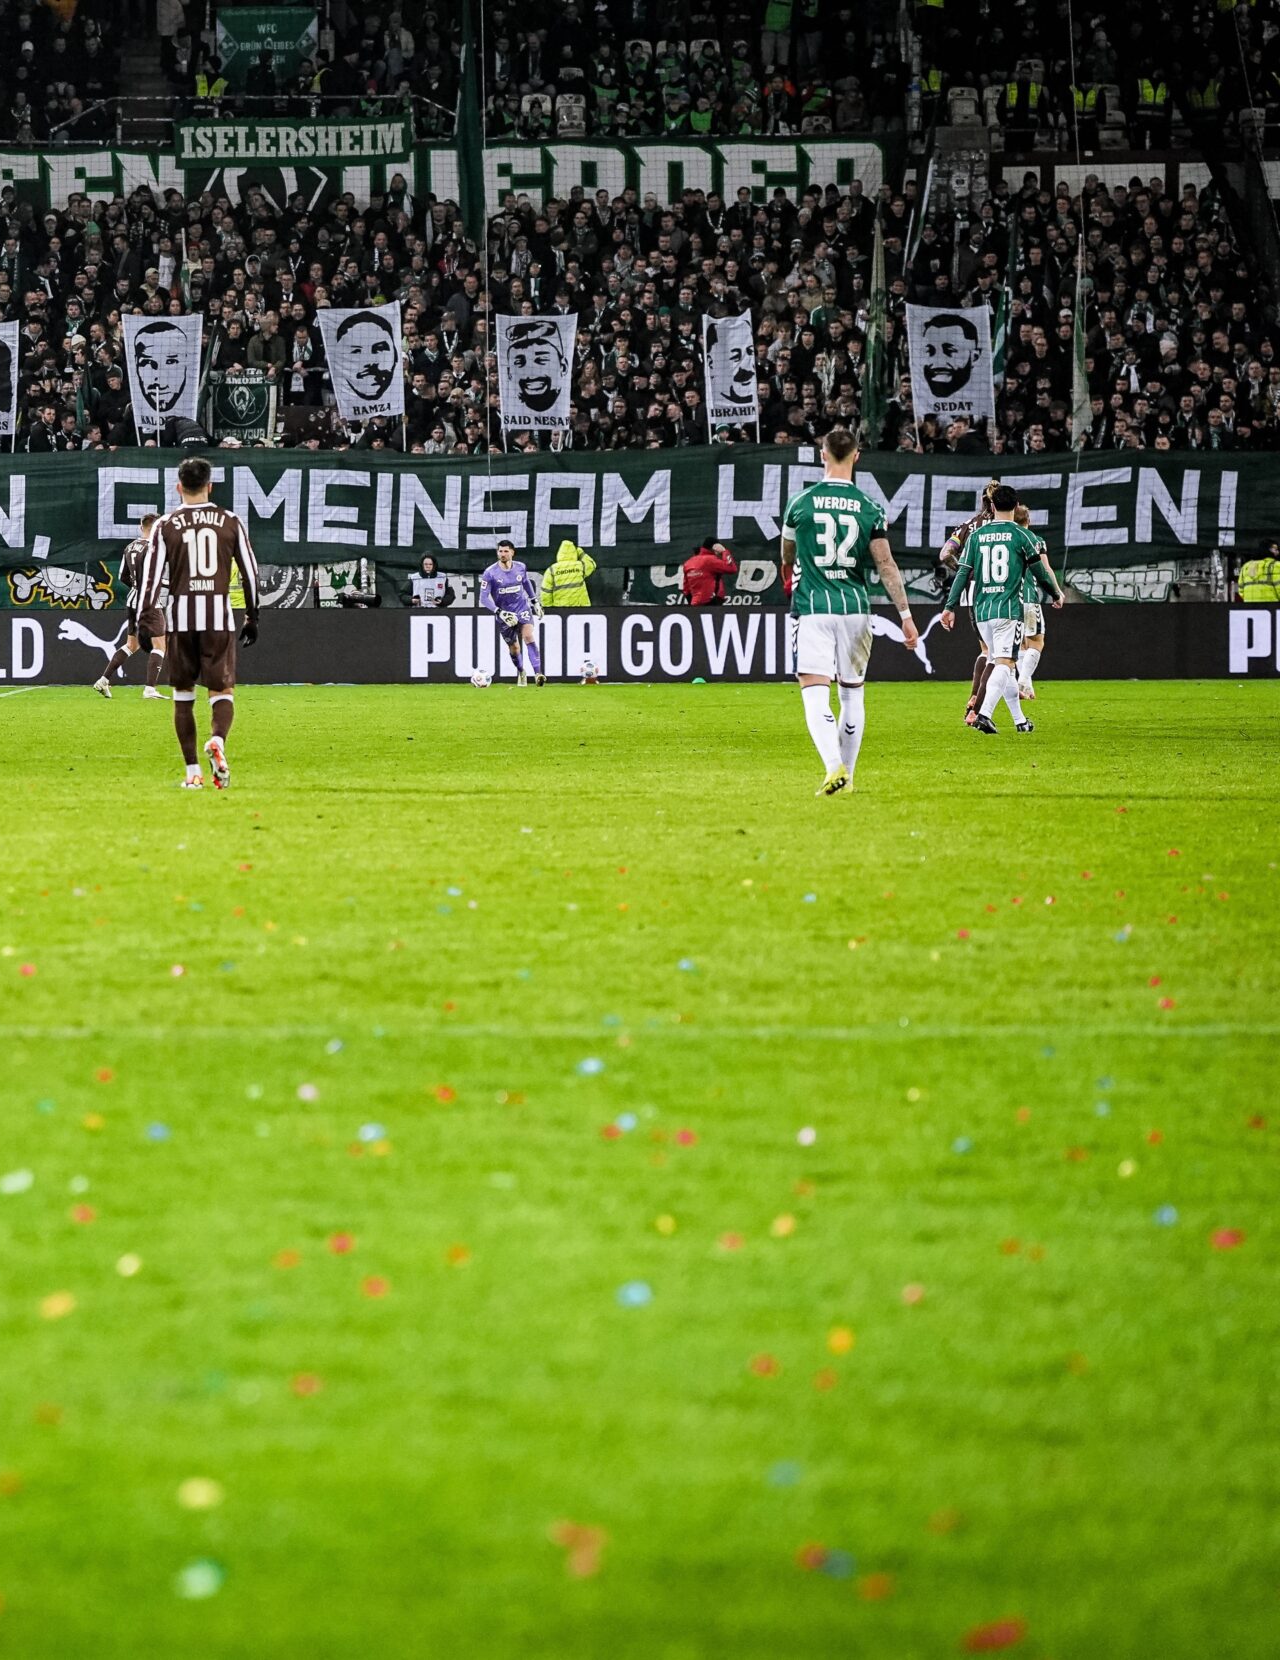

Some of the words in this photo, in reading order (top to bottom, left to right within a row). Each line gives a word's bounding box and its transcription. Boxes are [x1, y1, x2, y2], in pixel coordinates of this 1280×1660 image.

[180, 123, 405, 159] ISELERSHEIM
[933, 401, 973, 412] SEDAT
[504, 415, 531, 425] SAID
[716, 446, 1238, 549] KMPFEN!
[813, 496, 861, 513] WERDER
[172, 514, 192, 531] ST.
[192, 511, 226, 528] PAULI
[813, 513, 860, 567] 32
[978, 533, 1013, 543] WERDER
[182, 528, 218, 578] 10
[980, 544, 1010, 584] 18
[189, 580, 215, 591] SINANI
[722, 595, 762, 606] 2002
[620, 614, 693, 678] GO
